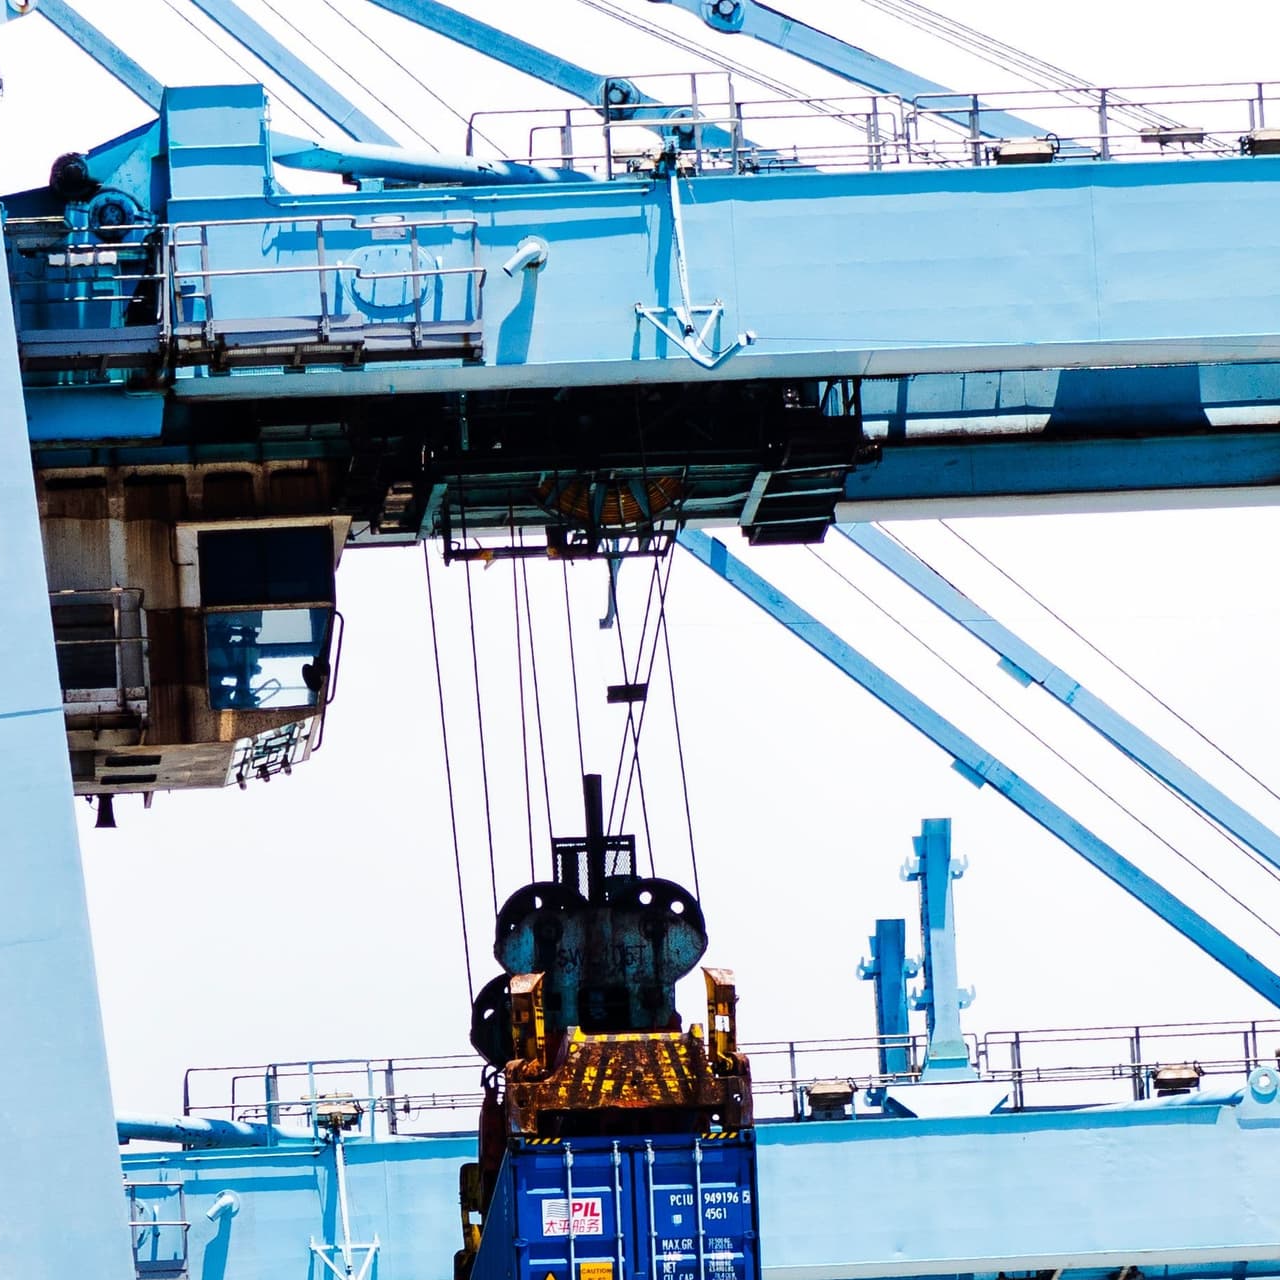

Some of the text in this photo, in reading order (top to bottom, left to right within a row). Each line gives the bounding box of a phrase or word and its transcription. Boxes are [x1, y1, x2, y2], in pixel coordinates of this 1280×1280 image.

[670, 1194, 694, 1206] PCIU
[704, 1192, 739, 1204] 949196
[571, 1201, 600, 1217] PIL
[705, 1207, 727, 1219] 45G1
[581, 1267, 612, 1275] CAUTION
